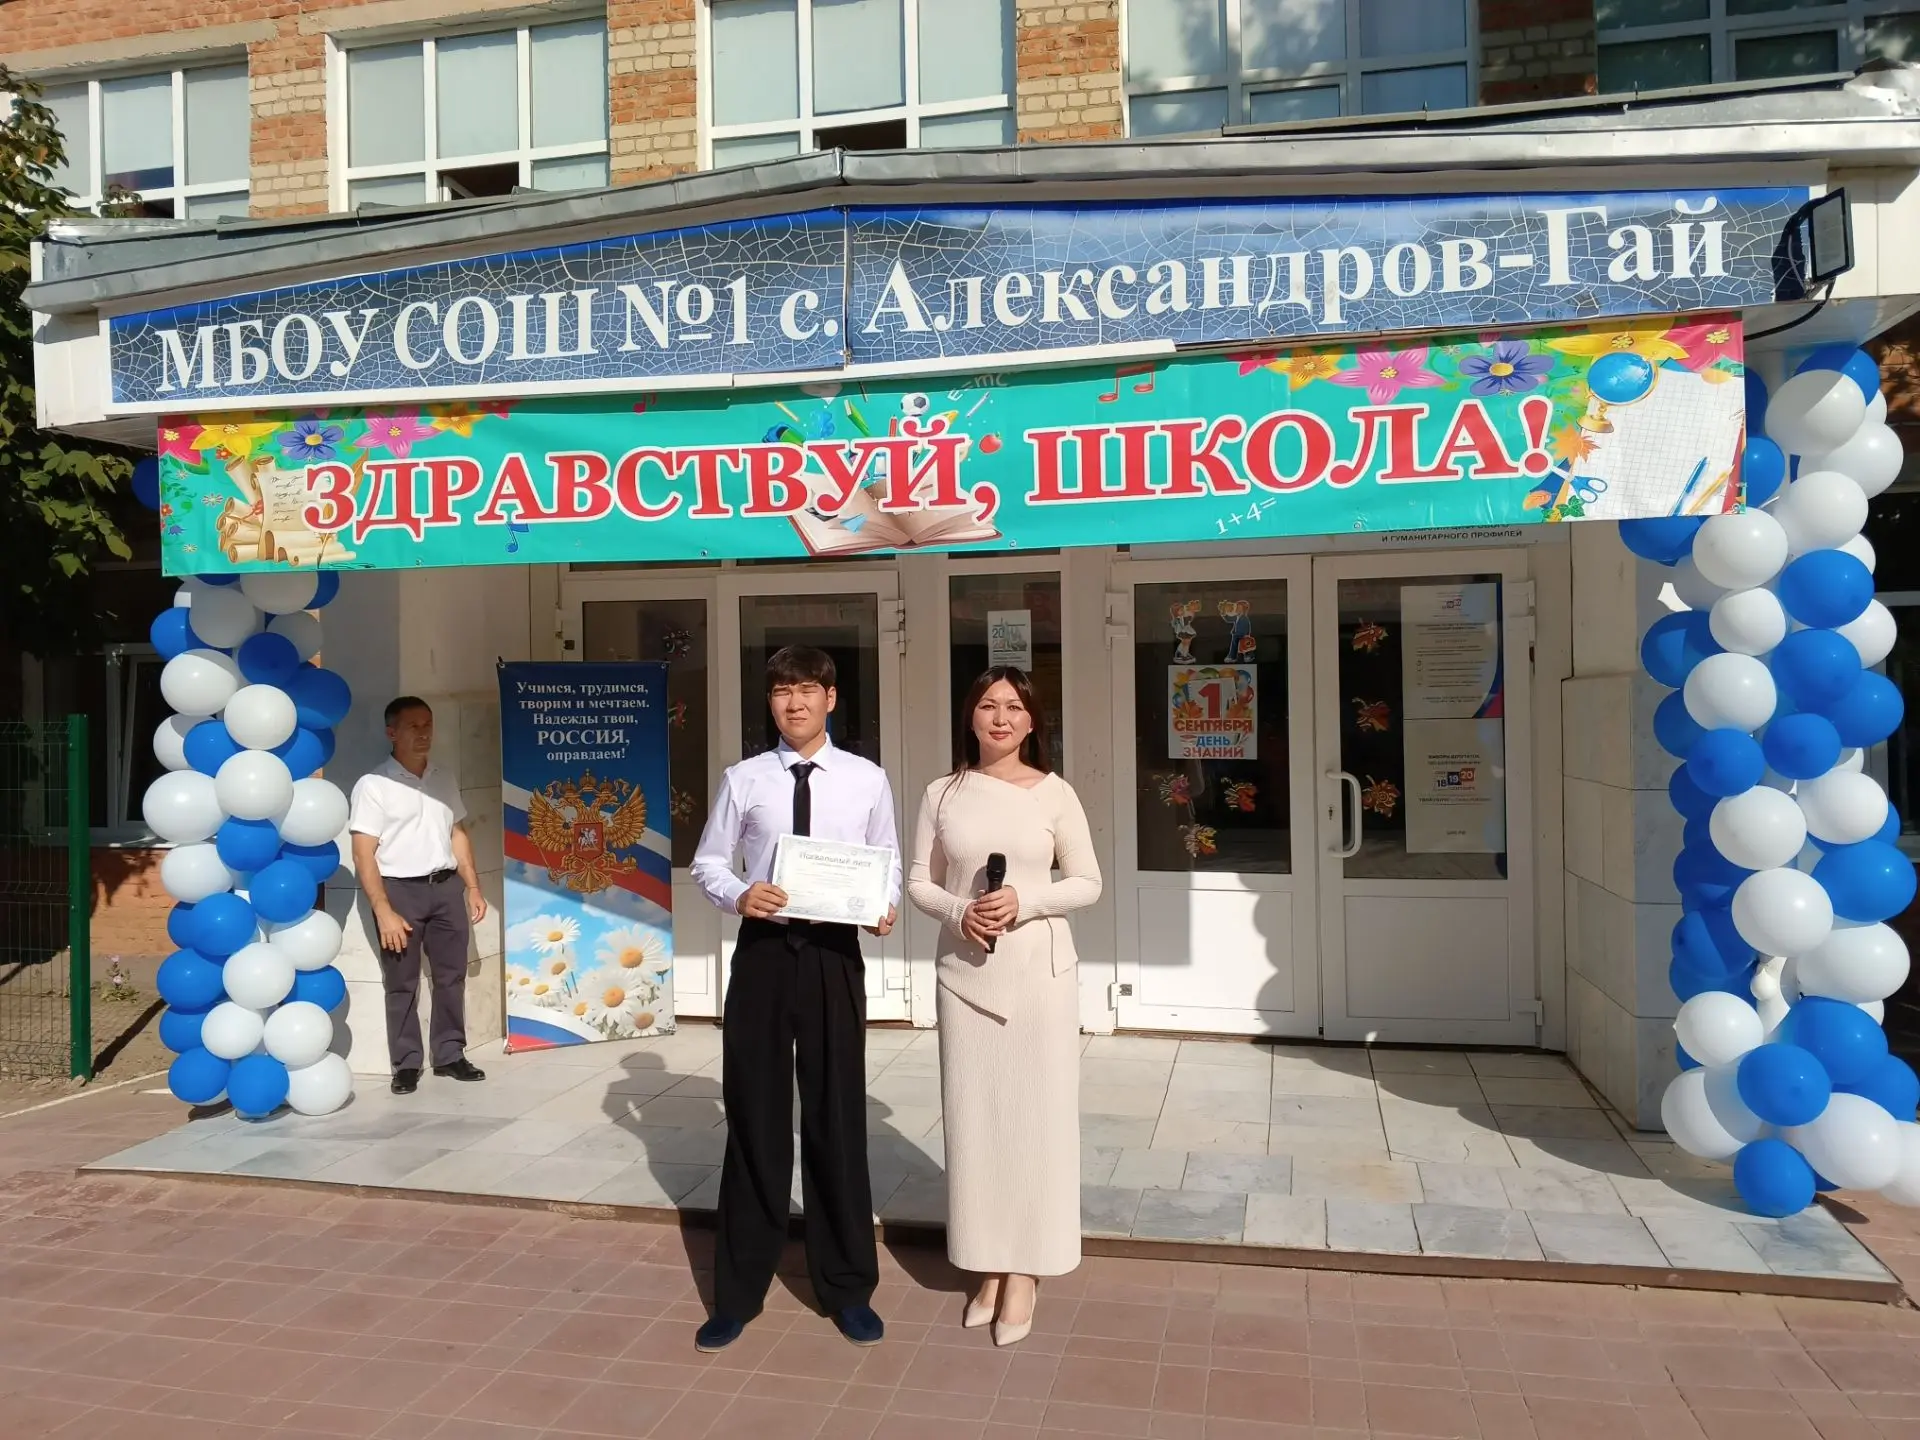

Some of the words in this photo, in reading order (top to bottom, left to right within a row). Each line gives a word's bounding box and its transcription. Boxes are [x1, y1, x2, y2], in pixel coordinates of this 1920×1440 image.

[155, 308, 380, 393] МБОУ
[393, 287, 600, 371] СОШ
[616, 274, 756, 352] №1
[779, 288, 840, 342] с.
[861, 195, 1730, 335] Александров-Гай
[303, 417, 998, 545] ЗДРАВСТВУЙ,
[1026, 395, 1552, 504] ШКОЛА!
[1381, 535, 1388, 543] И
[1390, 532, 1469, 542] ГУМАНИТАРНОГО
[1471, 530, 1523, 540] ПРОФИЛЕЙ
[516, 681, 576, 697] Учимся,
[580, 682, 649, 699] трудимся,
[518, 699, 572, 712] творим
[576, 701, 585, 709] и
[588, 699, 650, 709] мечтаем.
[1198, 683, 1222, 719] 1
[533, 713, 599, 726] Надежды
[602, 713, 639, 725] твои,
[1173, 719, 1254, 734] СЕНТЯБРЯ
[537, 729, 630, 747] РОССИЯ,
[1195, 735, 1231, 748] ДЕНЬ
[546, 747, 626, 764] оправдаем!
[1182, 745, 1244, 758] ЗНАНИЙ
[1448, 774, 1459, 784] 19
[1460, 770, 1474, 780] 20
